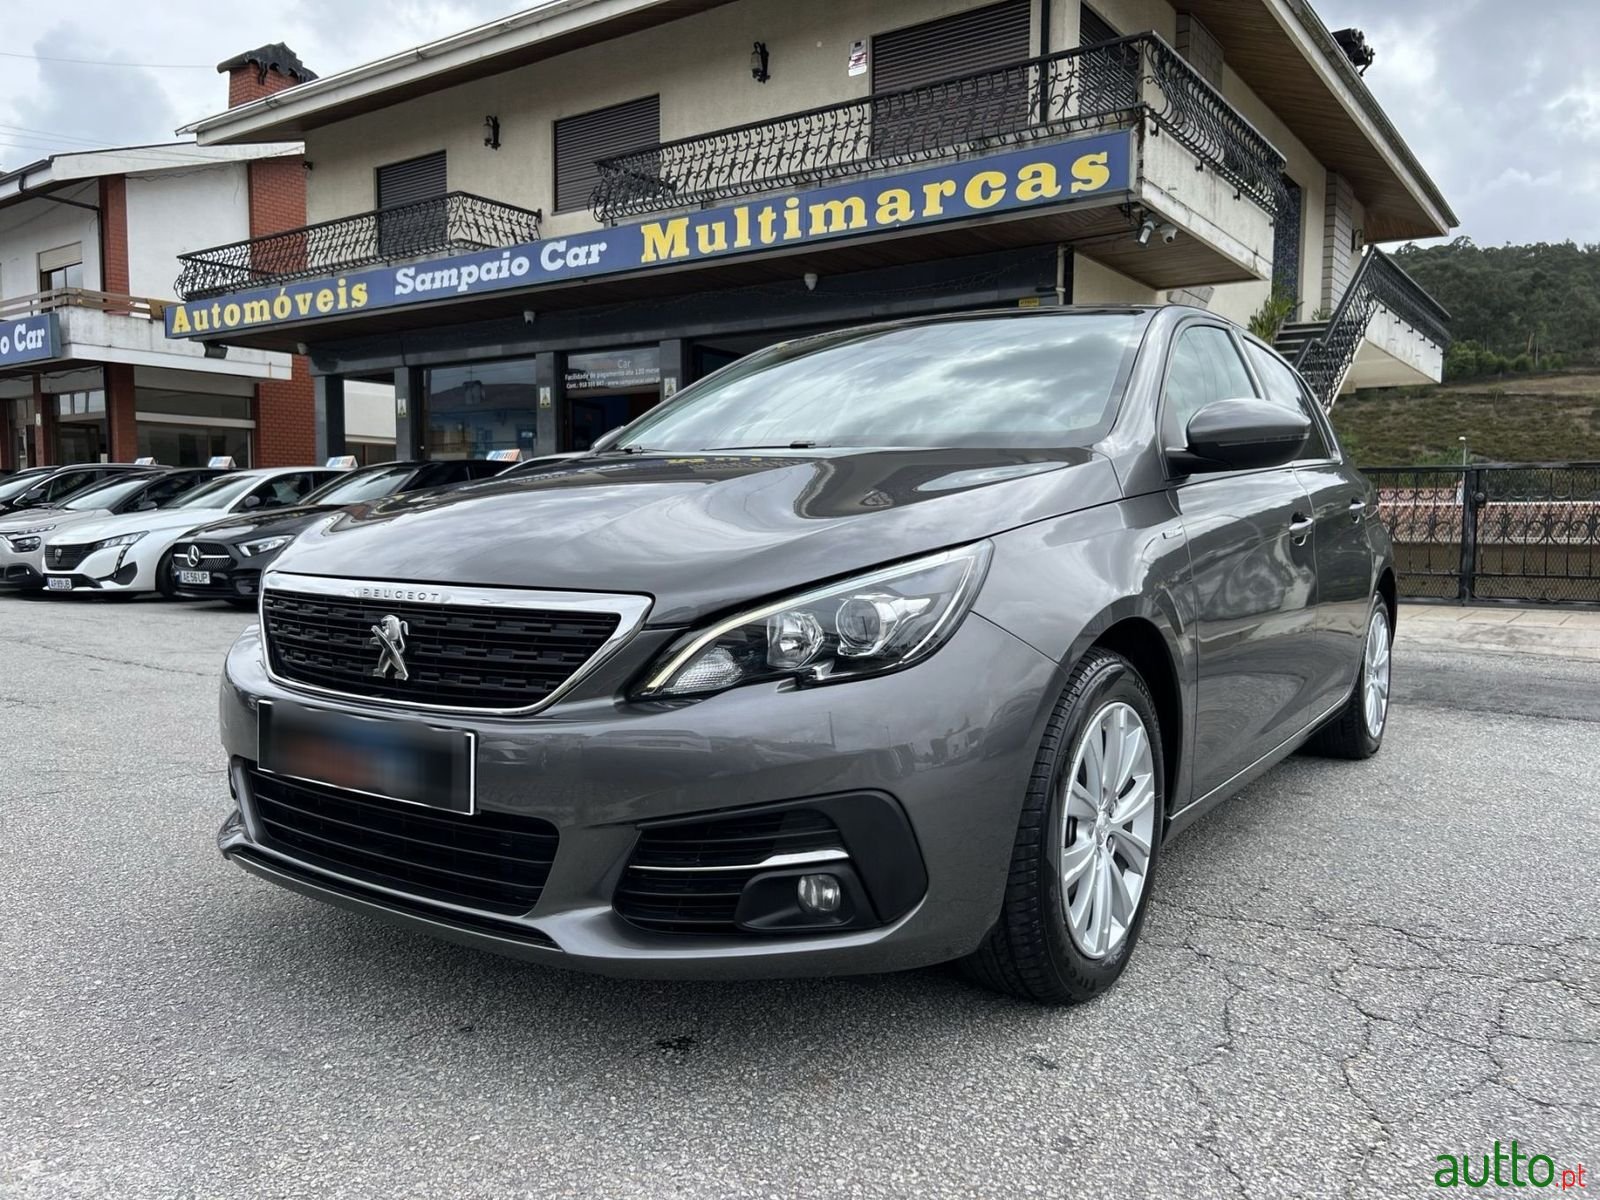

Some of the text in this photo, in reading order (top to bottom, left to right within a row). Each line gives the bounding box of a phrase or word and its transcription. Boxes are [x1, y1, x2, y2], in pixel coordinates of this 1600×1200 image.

[171, 151, 1112, 334] Automóveis Sampaio Car Multimarcas
[13, 323, 46, 352] Car
[617, 359, 632, 369] Car
[362, 588, 440, 601] PEUGEOT
